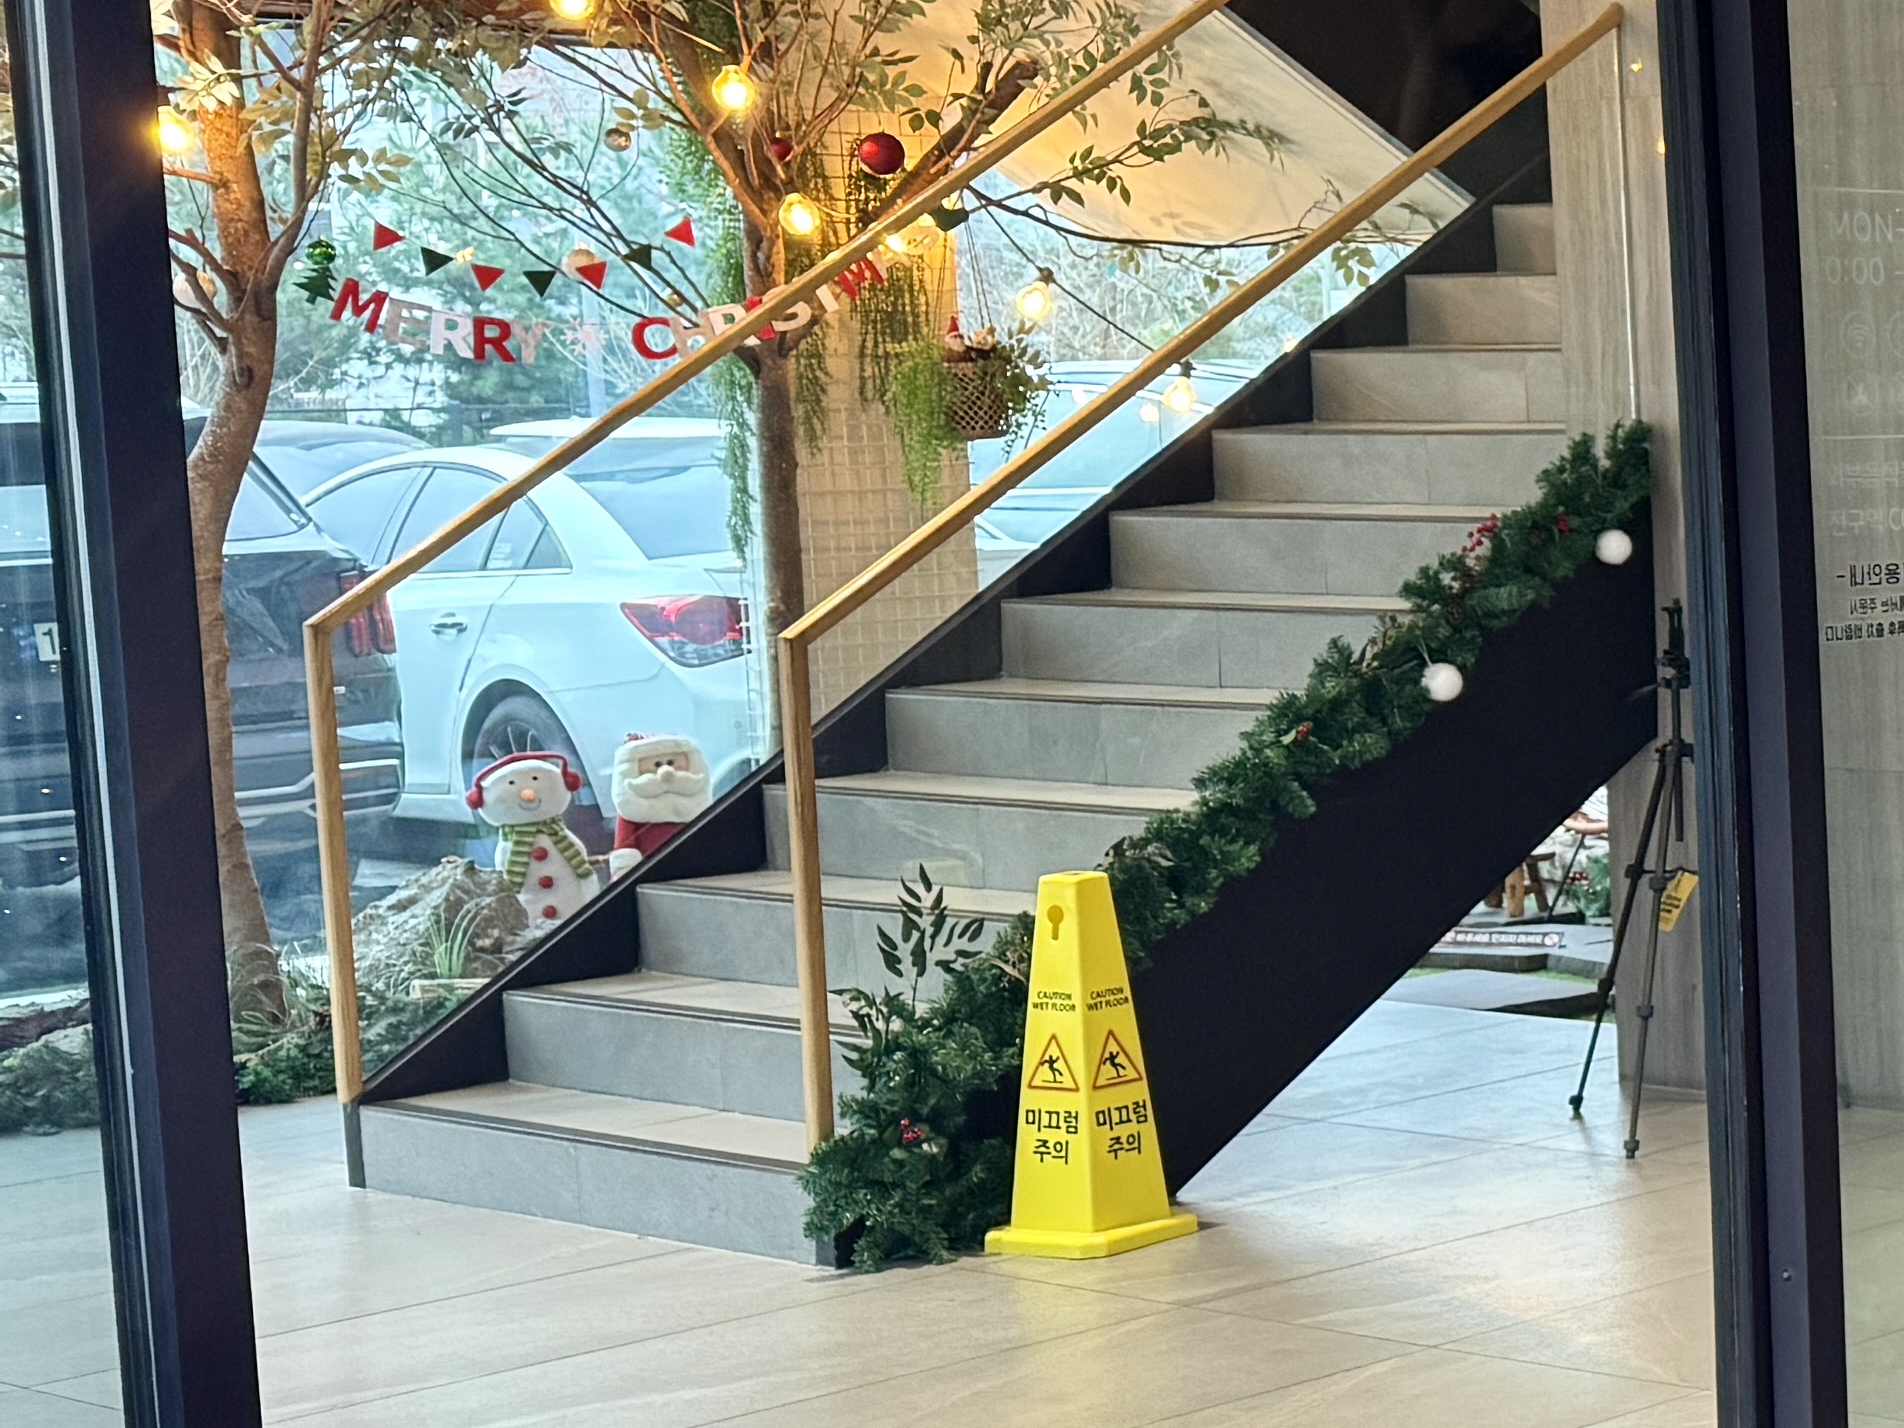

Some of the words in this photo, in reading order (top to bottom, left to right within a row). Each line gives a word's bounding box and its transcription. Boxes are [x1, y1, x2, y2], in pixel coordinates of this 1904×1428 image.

[329, 276, 547, 365] MERRY
[1037, 990, 1072, 1001] CAUTION
[1086, 1000, 1104, 1012] WET
[1105, 996, 1130, 1008] FLOOR
[1090, 987, 1124, 1000] CAUTION
[1032, 1002, 1049, 1011] WET
[1051, 1003, 1076, 1012] FLOOR
[1026, 1109, 1078, 1134] 미끄럼
[1095, 1099, 1148, 1132] 미끄럼
[1033, 1138, 1069, 1165] 주의
[1107, 1130, 1141, 1160] 주의
